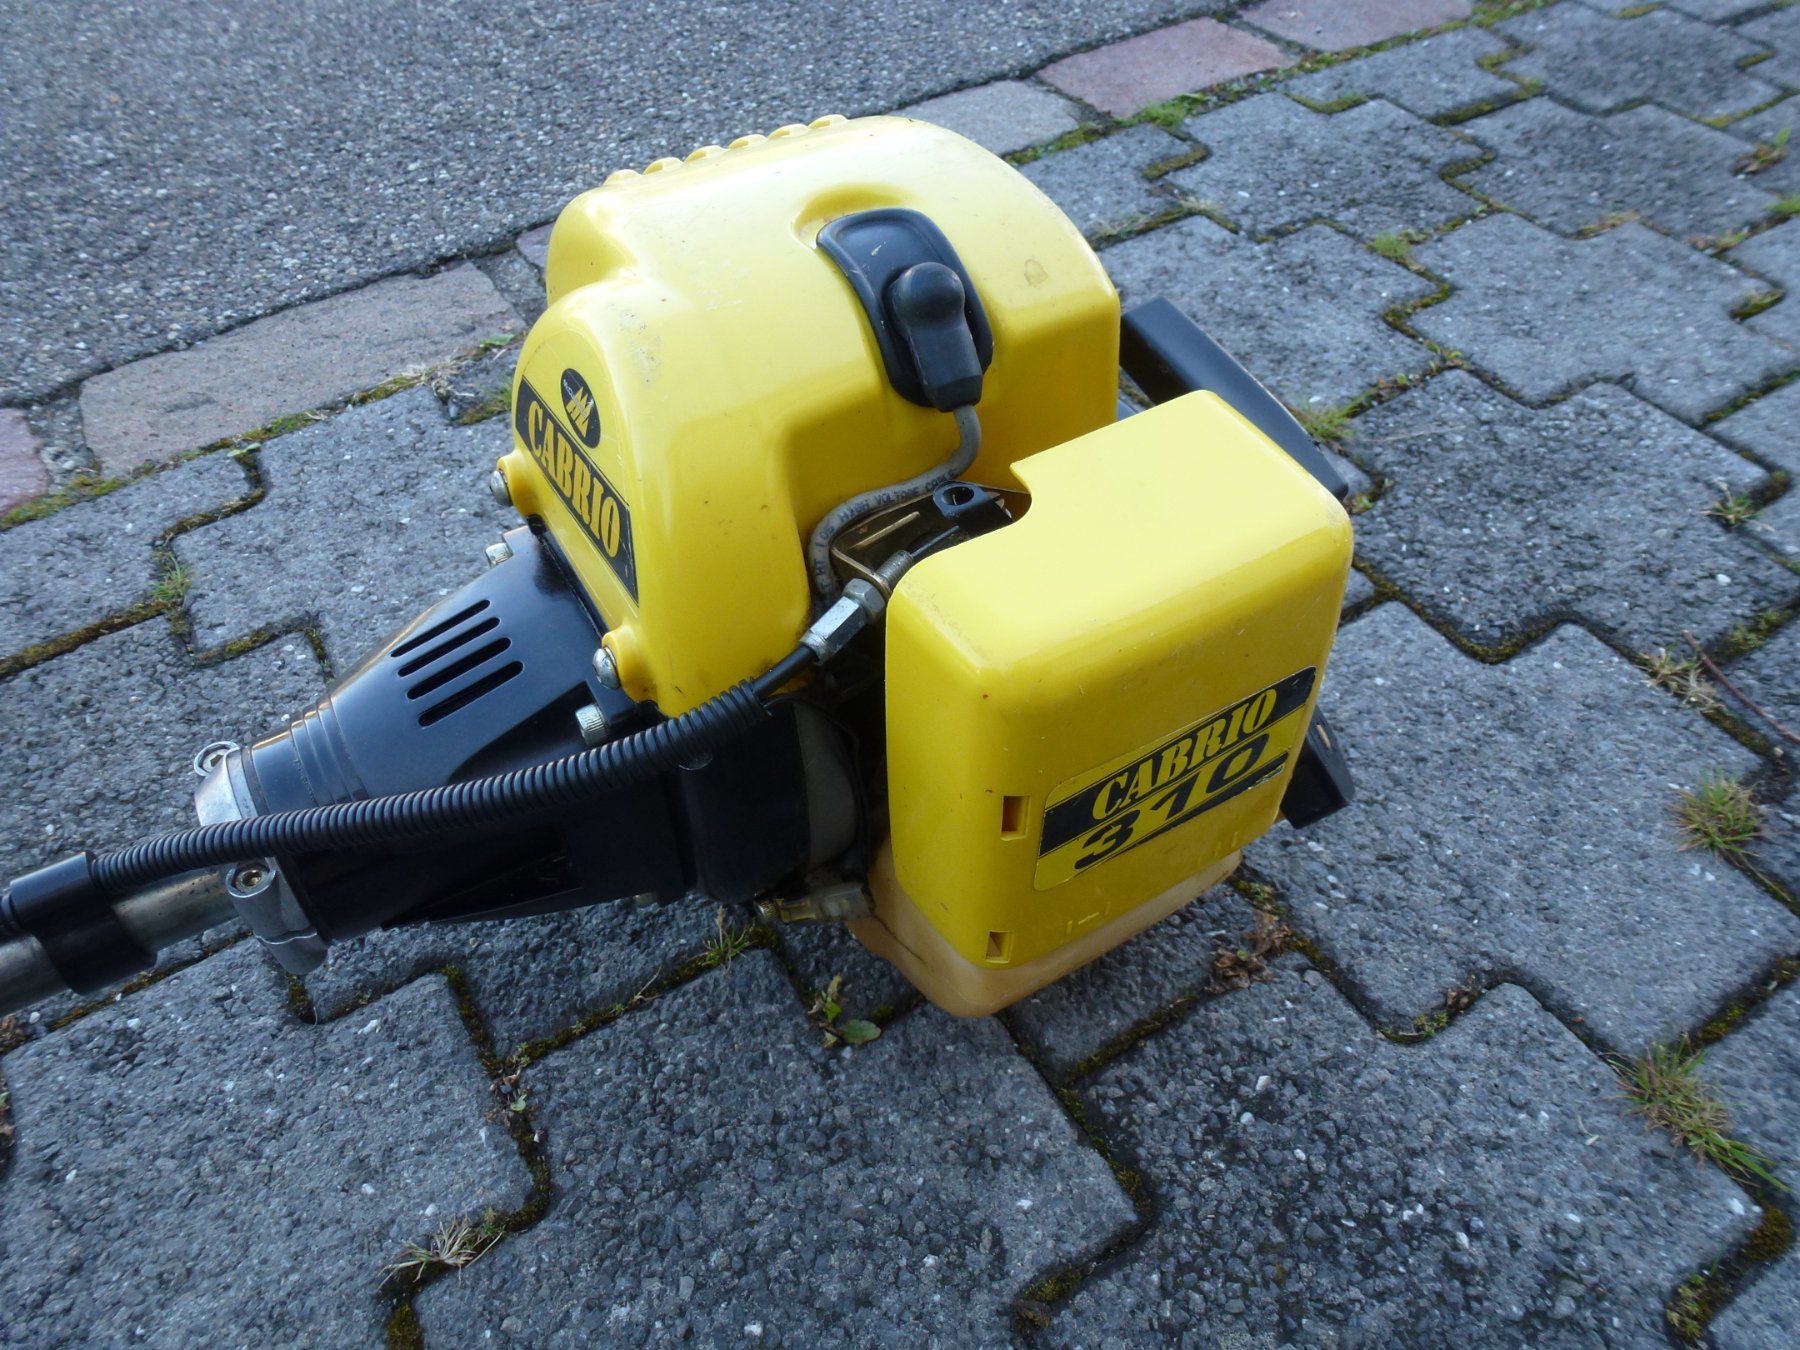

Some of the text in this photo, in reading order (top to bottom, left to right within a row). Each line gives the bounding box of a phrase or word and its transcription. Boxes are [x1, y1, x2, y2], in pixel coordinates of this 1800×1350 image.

[528, 400, 621, 558] CABRIO
[1074, 733, 1270, 870] 310
[1092, 688, 1277, 820] CABRIO
